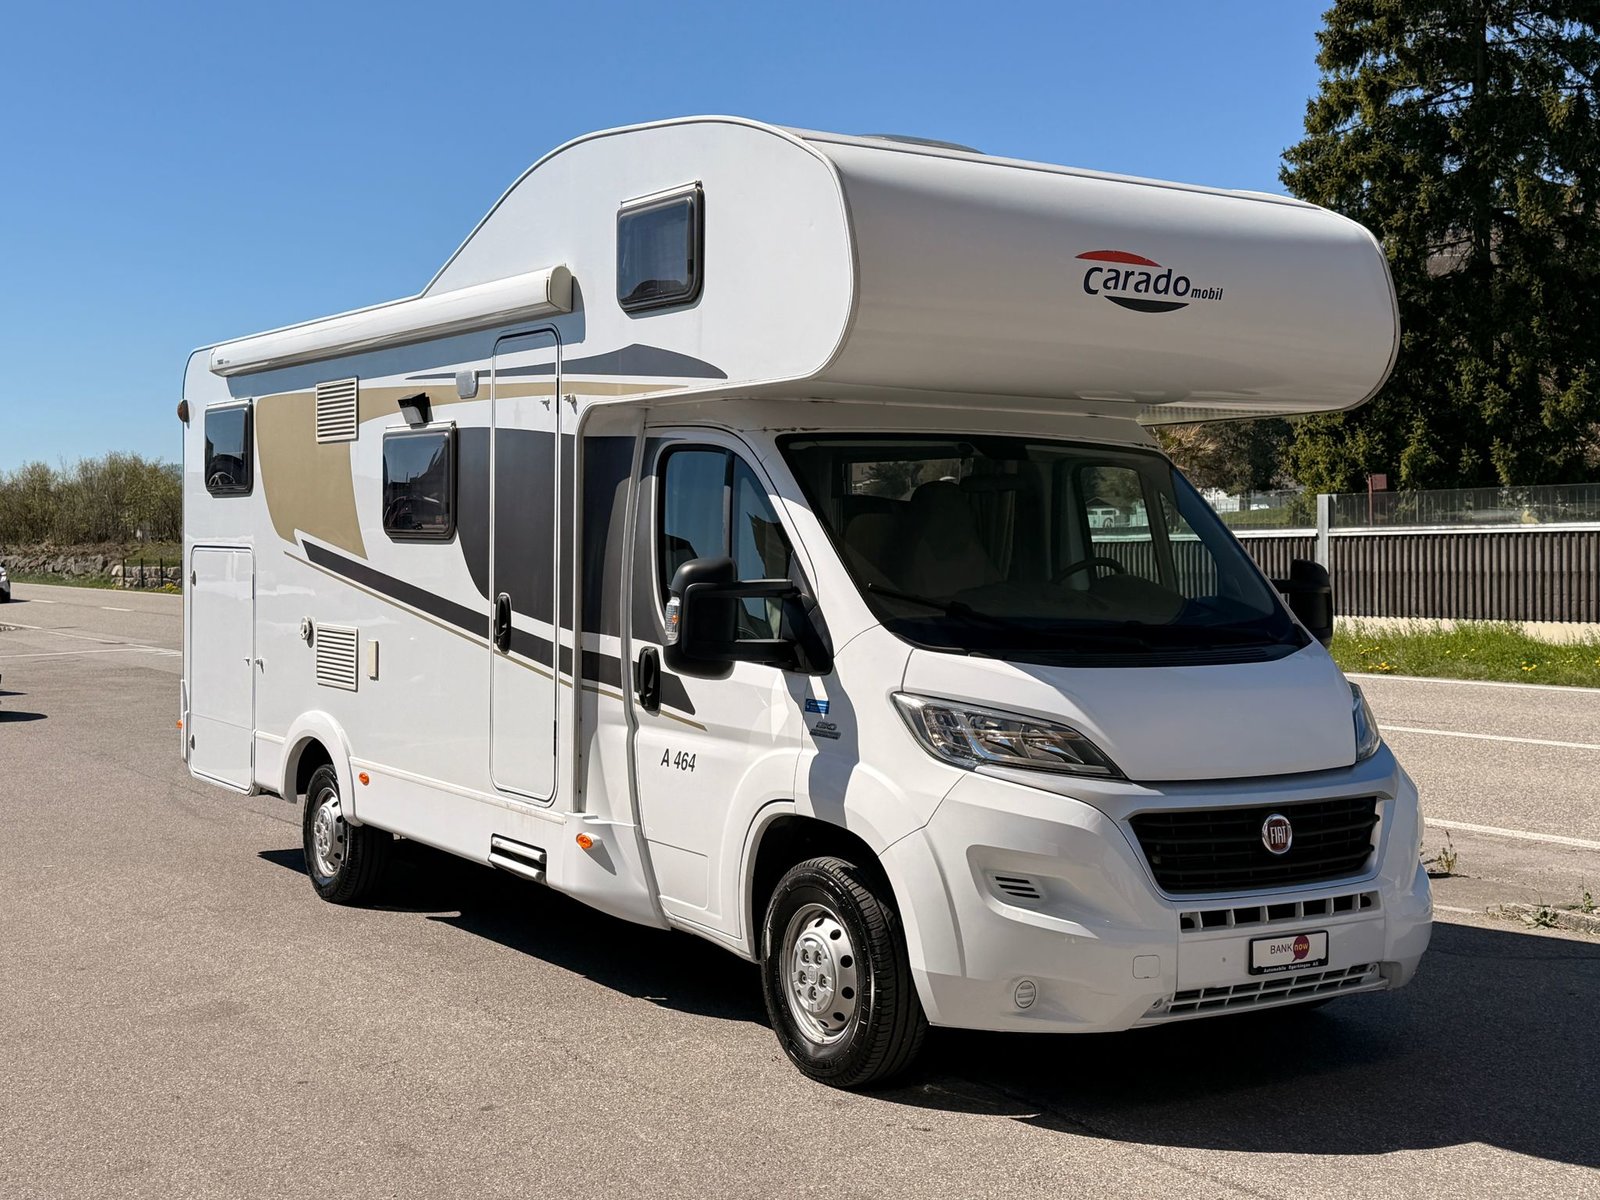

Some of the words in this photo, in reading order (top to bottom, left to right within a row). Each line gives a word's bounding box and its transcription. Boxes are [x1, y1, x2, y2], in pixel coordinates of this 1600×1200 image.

[1190, 287, 1223, 300] mobil
[660, 748, 669, 767] A
[673, 750, 696, 772] 464
[1270, 825, 1286, 844] FIAT
[1270, 943, 1292, 954] BANK
[1294, 943, 1308, 951] now
